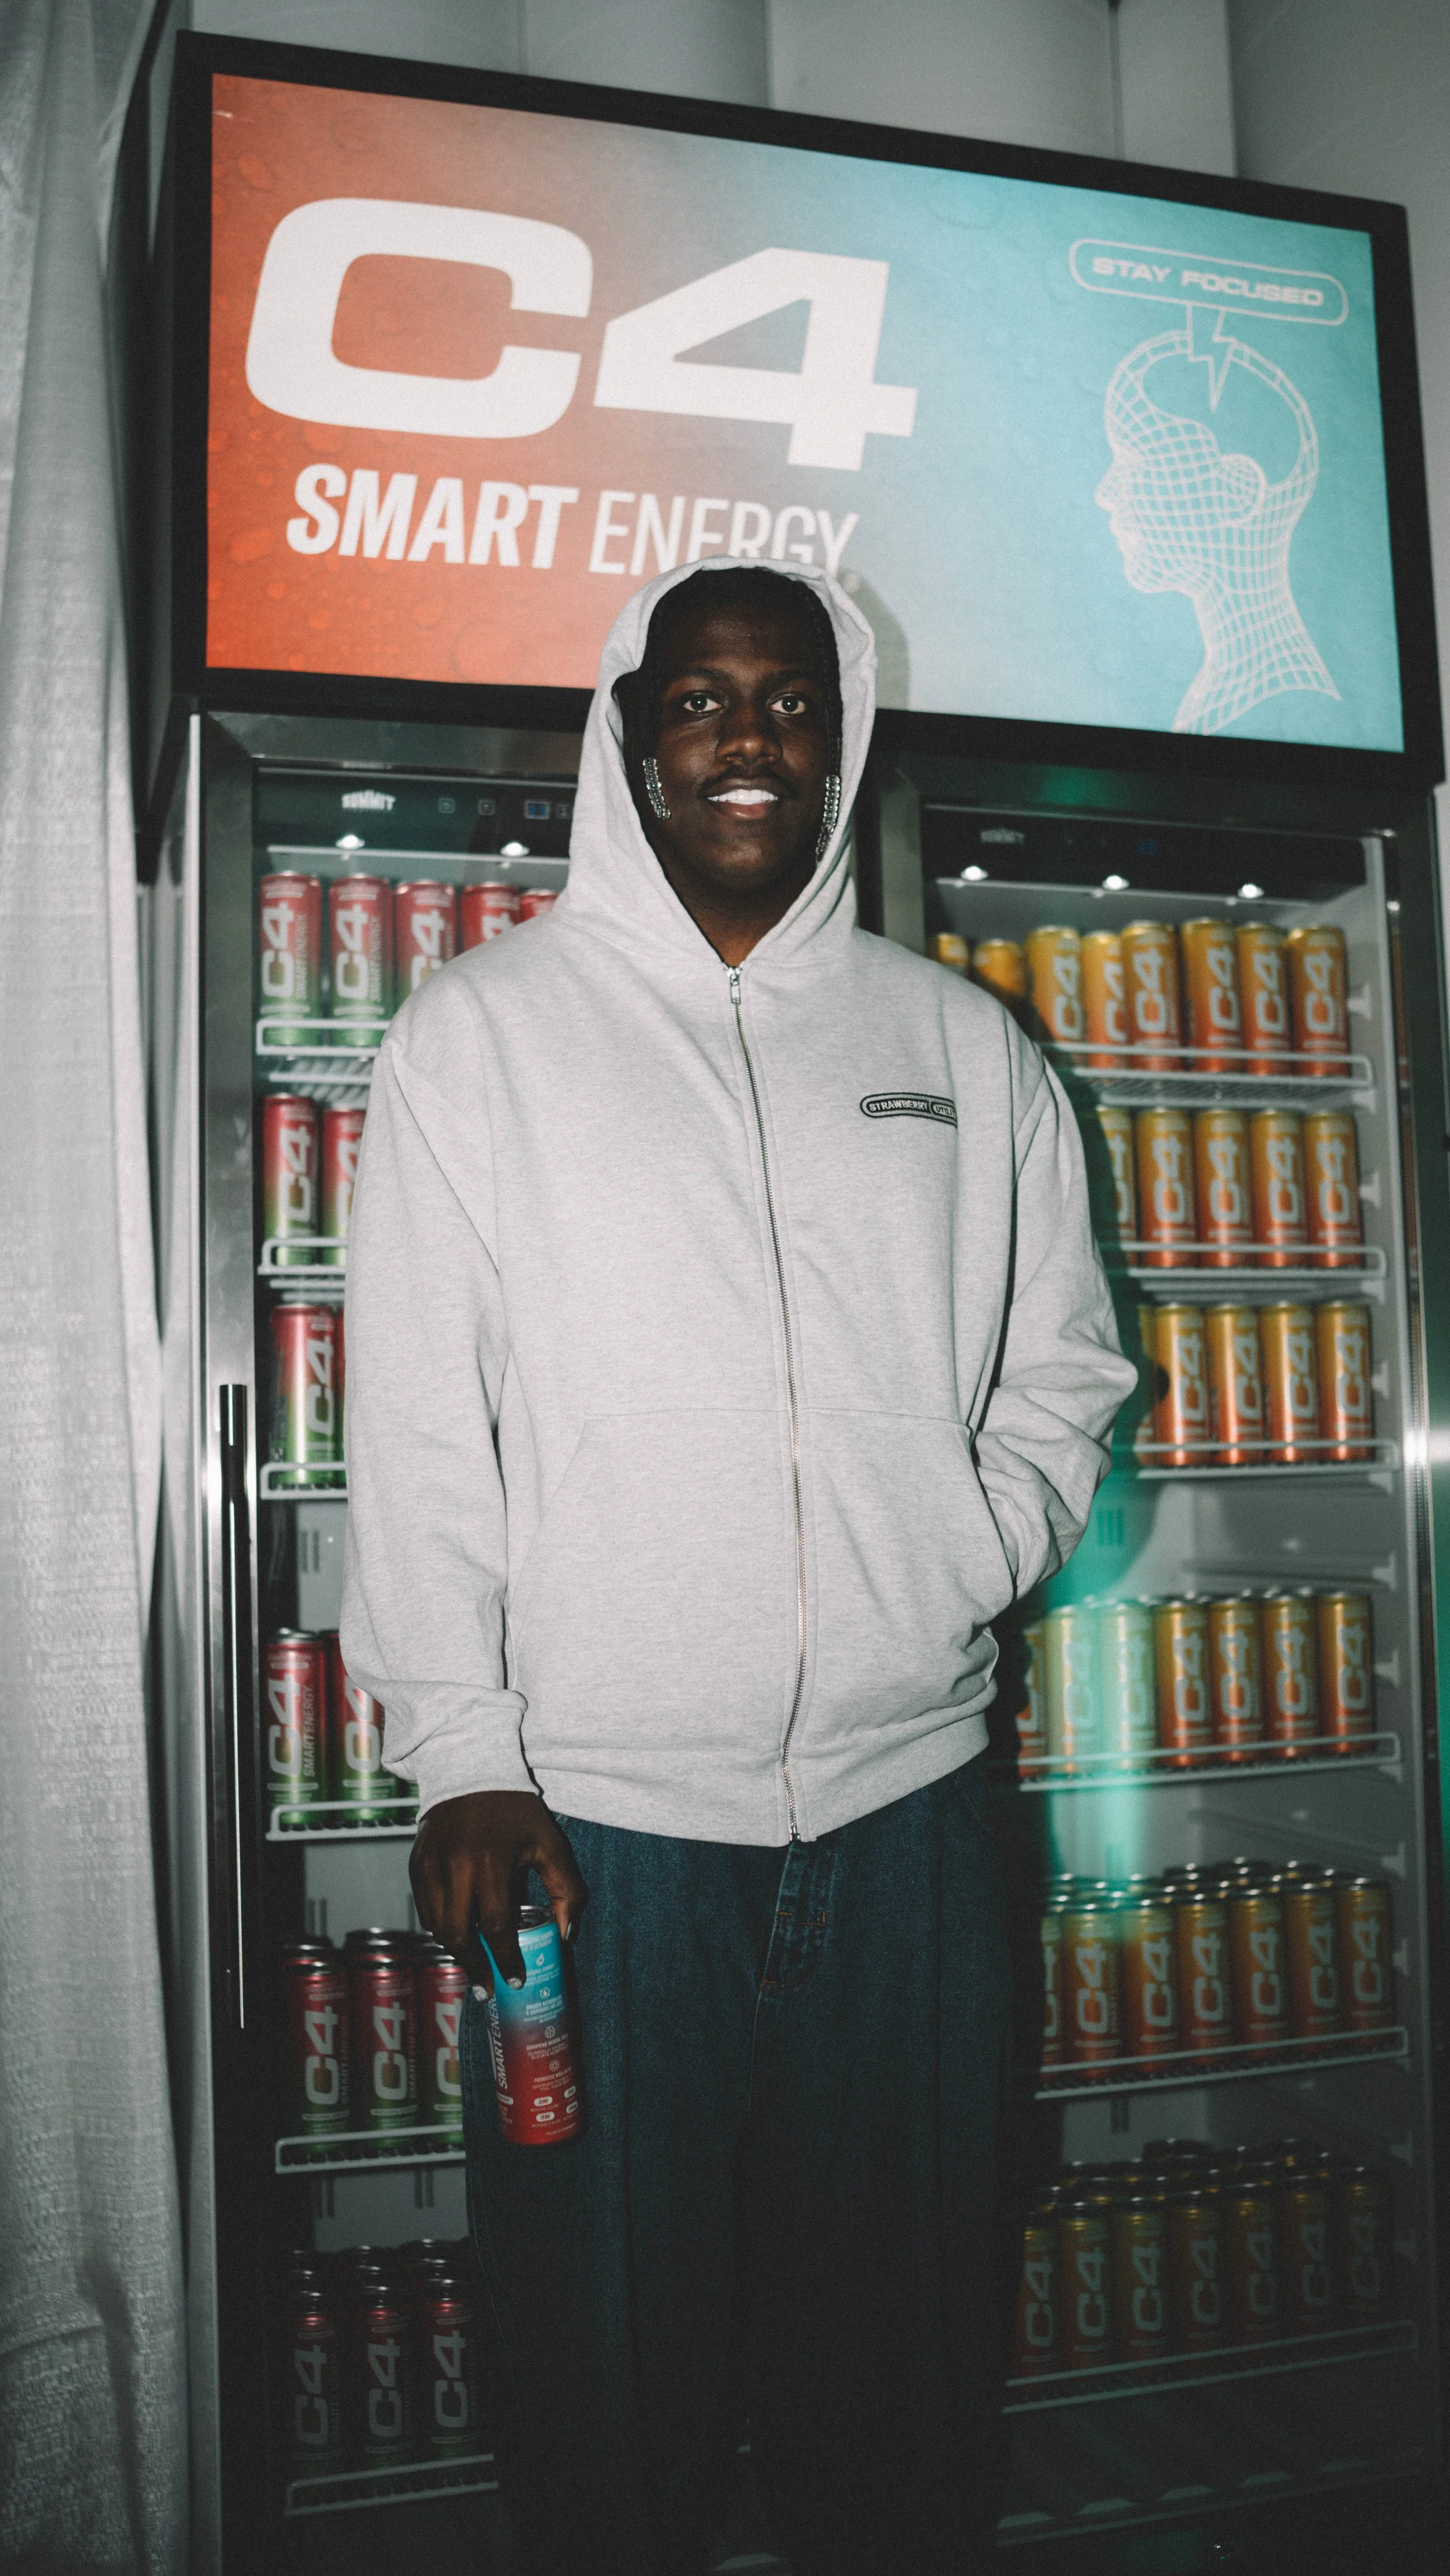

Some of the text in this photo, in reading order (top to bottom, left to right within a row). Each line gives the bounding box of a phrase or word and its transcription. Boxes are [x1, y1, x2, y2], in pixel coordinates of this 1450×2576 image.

[1092, 257, 1324, 306] STAY FOCUSED
[246, 197, 918, 470] C4
[287, 464, 579, 569] SMART
[262, 902, 294, 997] C4
[335, 904, 369, 999] C4
[1132, 949, 1166, 1033] C4
[1207, 946, 1239, 1030] C4
[1253, 950, 1285, 1033] C4
[1304, 950, 1335, 1033] C4
[1053, 955, 1083, 1039] C4
[869, 1100, 928, 1111] STRAWBERRY
[279, 1125, 311, 1222] C4
[1152, 1135, 1186, 1224] C4
[1207, 1135, 1242, 1224] C4
[1266, 1137, 1301, 1224] C4
[1315, 1137, 1350, 1224] C4
[306, 1336, 334, 1435] C4
[1176, 1331, 1205, 1421] C4
[1233, 1331, 1262, 1420] C4
[1286, 1331, 1315, 1418] C4
[1335, 1329, 1366, 1417] C4
[1172, 1631, 1207, 1722] C4
[1218, 1628, 1252, 1719] C4
[1274, 1626, 1308, 1716] C4
[1336, 1623, 1369, 1710] C4
[268, 1674, 302, 1777] C4
[303, 1734, 315, 1777] SMART
[1075, 1942, 1109, 2034] C4
[1141, 1936, 1173, 2027] C4
[1192, 1932, 1224, 2021] C4
[1249, 1926, 1281, 2015] C4
[1307, 1921, 1337, 2008] C4
[1350, 1916, 1383, 2003] C4
[305, 2005, 339, 2105] C4
[373, 2001, 407, 2100] C4
[493, 2040, 507, 2089] SMART
[1024, 2256, 1054, 2348] C4
[1075, 2247, 1107, 2338] C4
[1131, 2242, 1163, 2332] C4
[295, 2345, 328, 2444] C4
[368, 2338, 402, 2437] C4
[433, 2330, 468, 2428] C4
